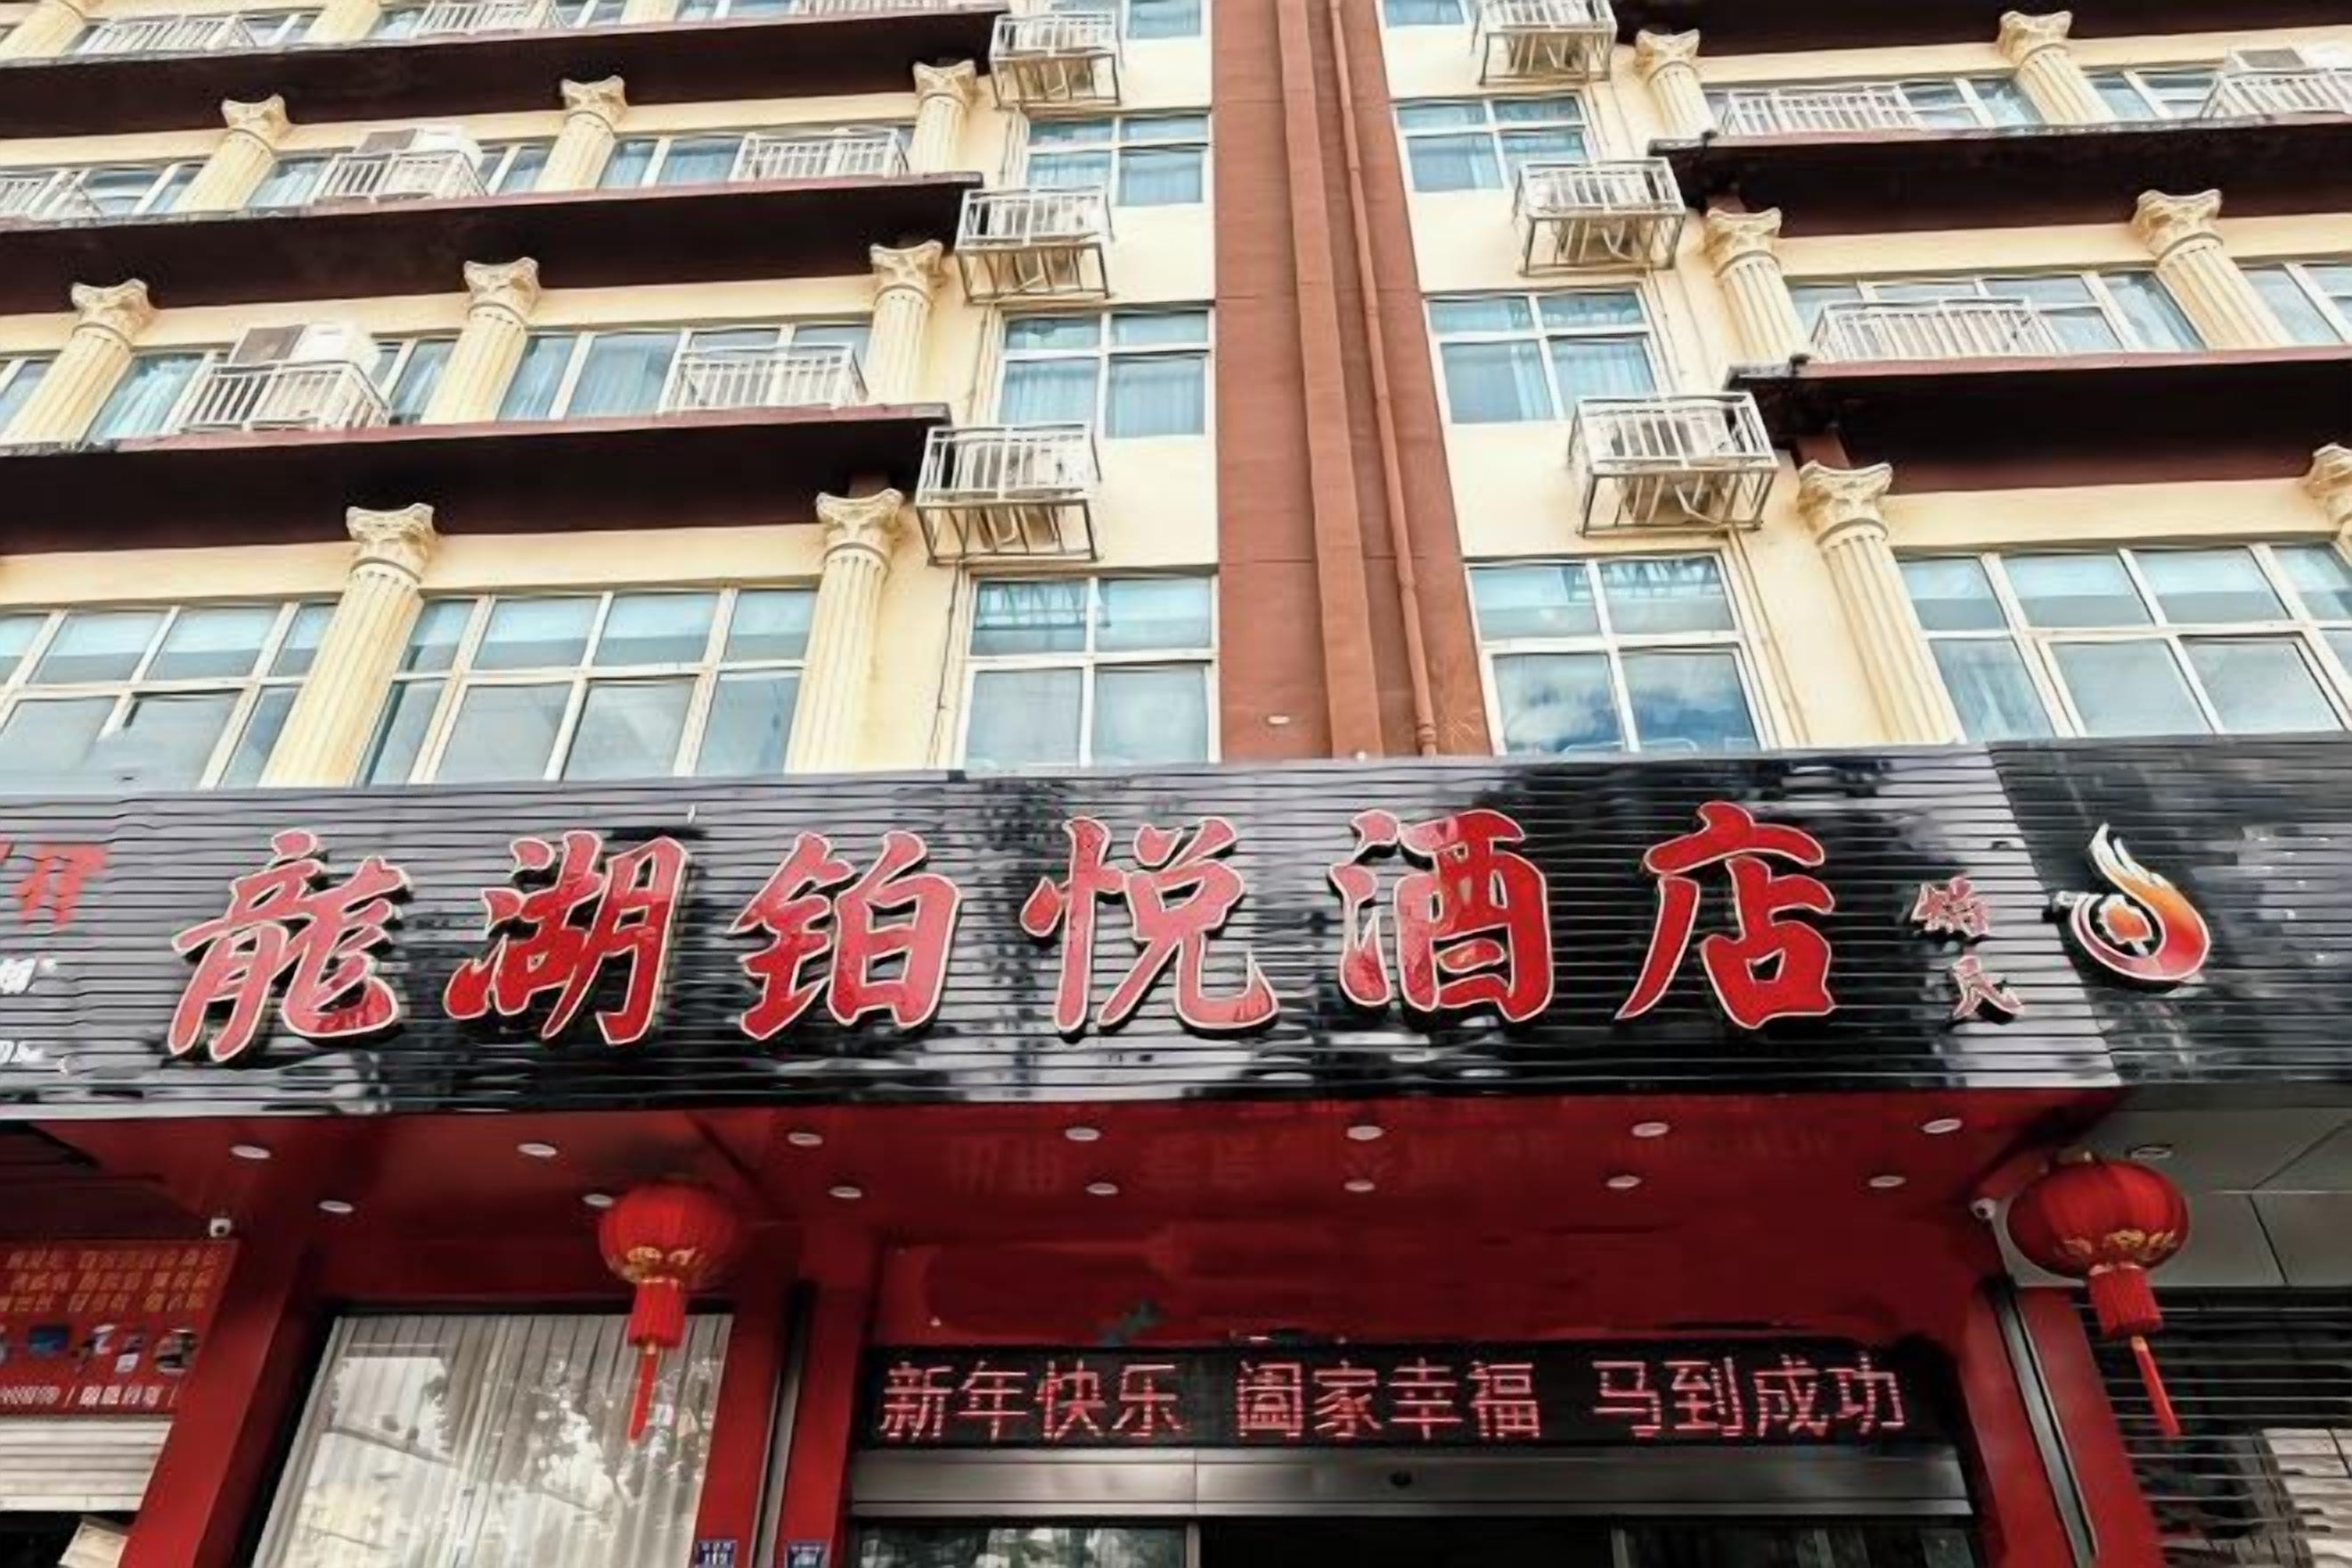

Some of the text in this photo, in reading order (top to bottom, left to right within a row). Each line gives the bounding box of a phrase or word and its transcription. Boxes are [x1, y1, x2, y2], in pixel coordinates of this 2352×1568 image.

[167, 801, 1836, 1062] 龍湖铂悦酒店
[879, 1353, 1906, 1441] 新年快乐 阖家幸福 马到成功
